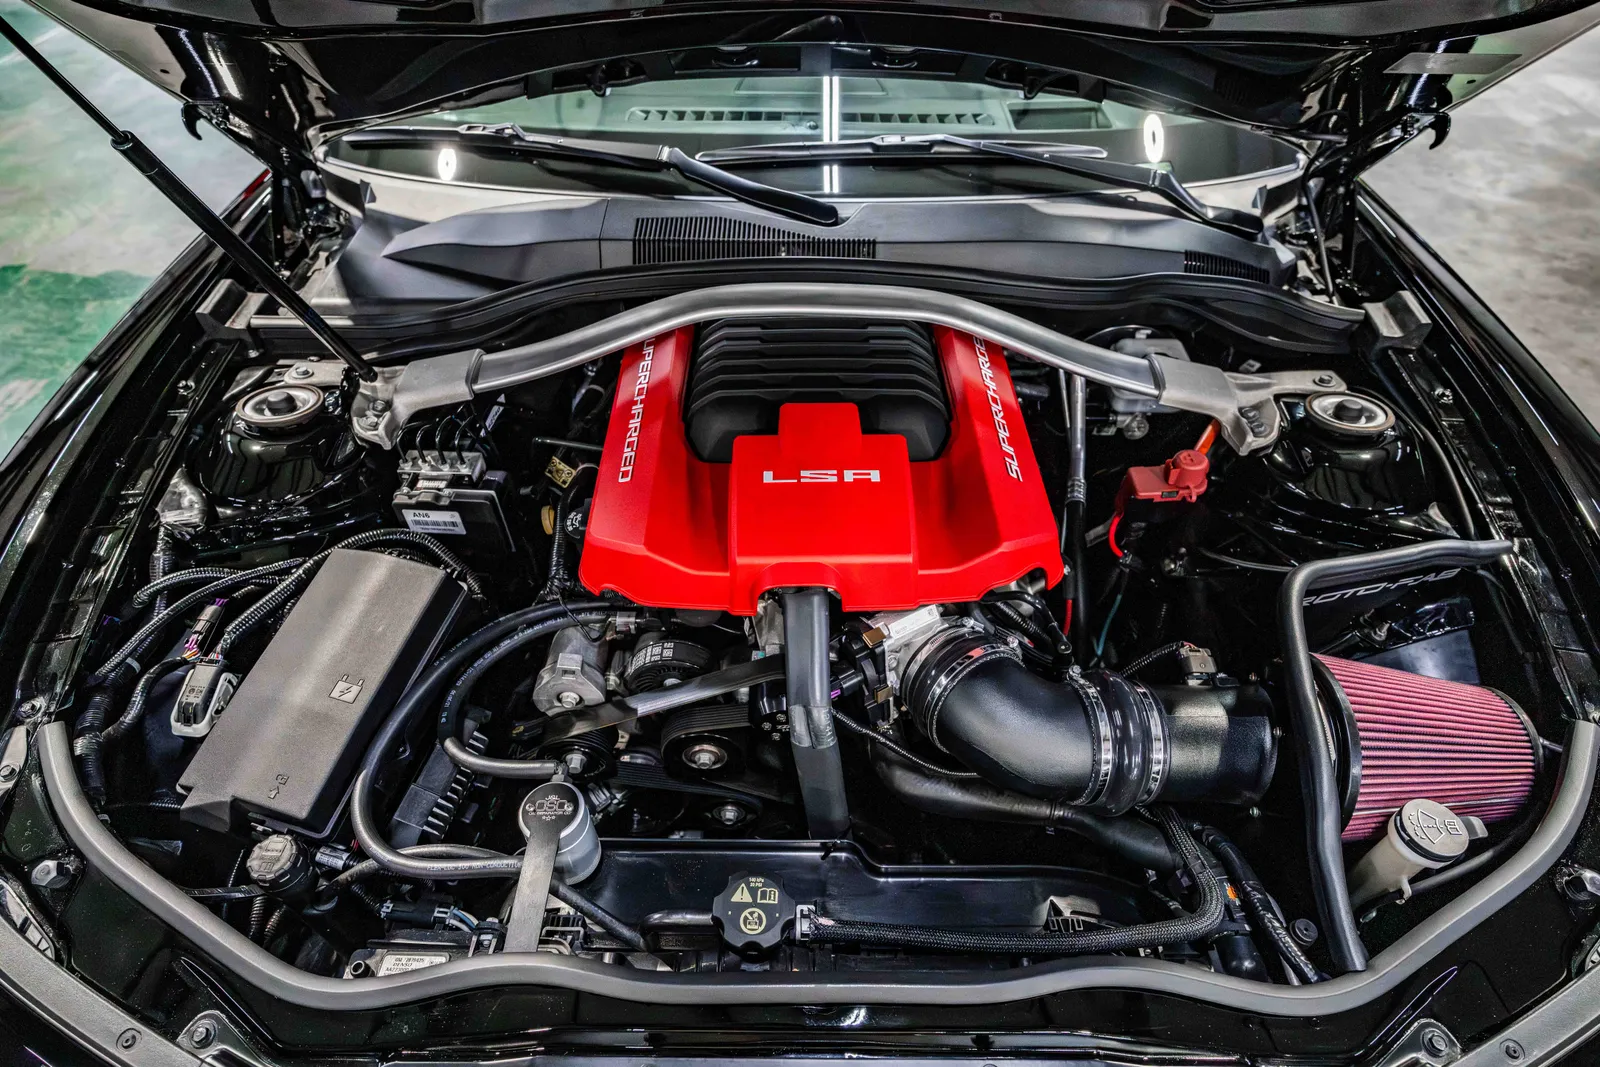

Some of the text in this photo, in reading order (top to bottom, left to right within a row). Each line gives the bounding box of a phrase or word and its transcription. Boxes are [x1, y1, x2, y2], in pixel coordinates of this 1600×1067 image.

[618, 338, 655, 483] UPERCHARGED
[973, 336, 1023, 482] SUPERCHARGE
[763, 469, 881, 483] LSA
[1303, 567, 1462, 606] ROTO-FAB
